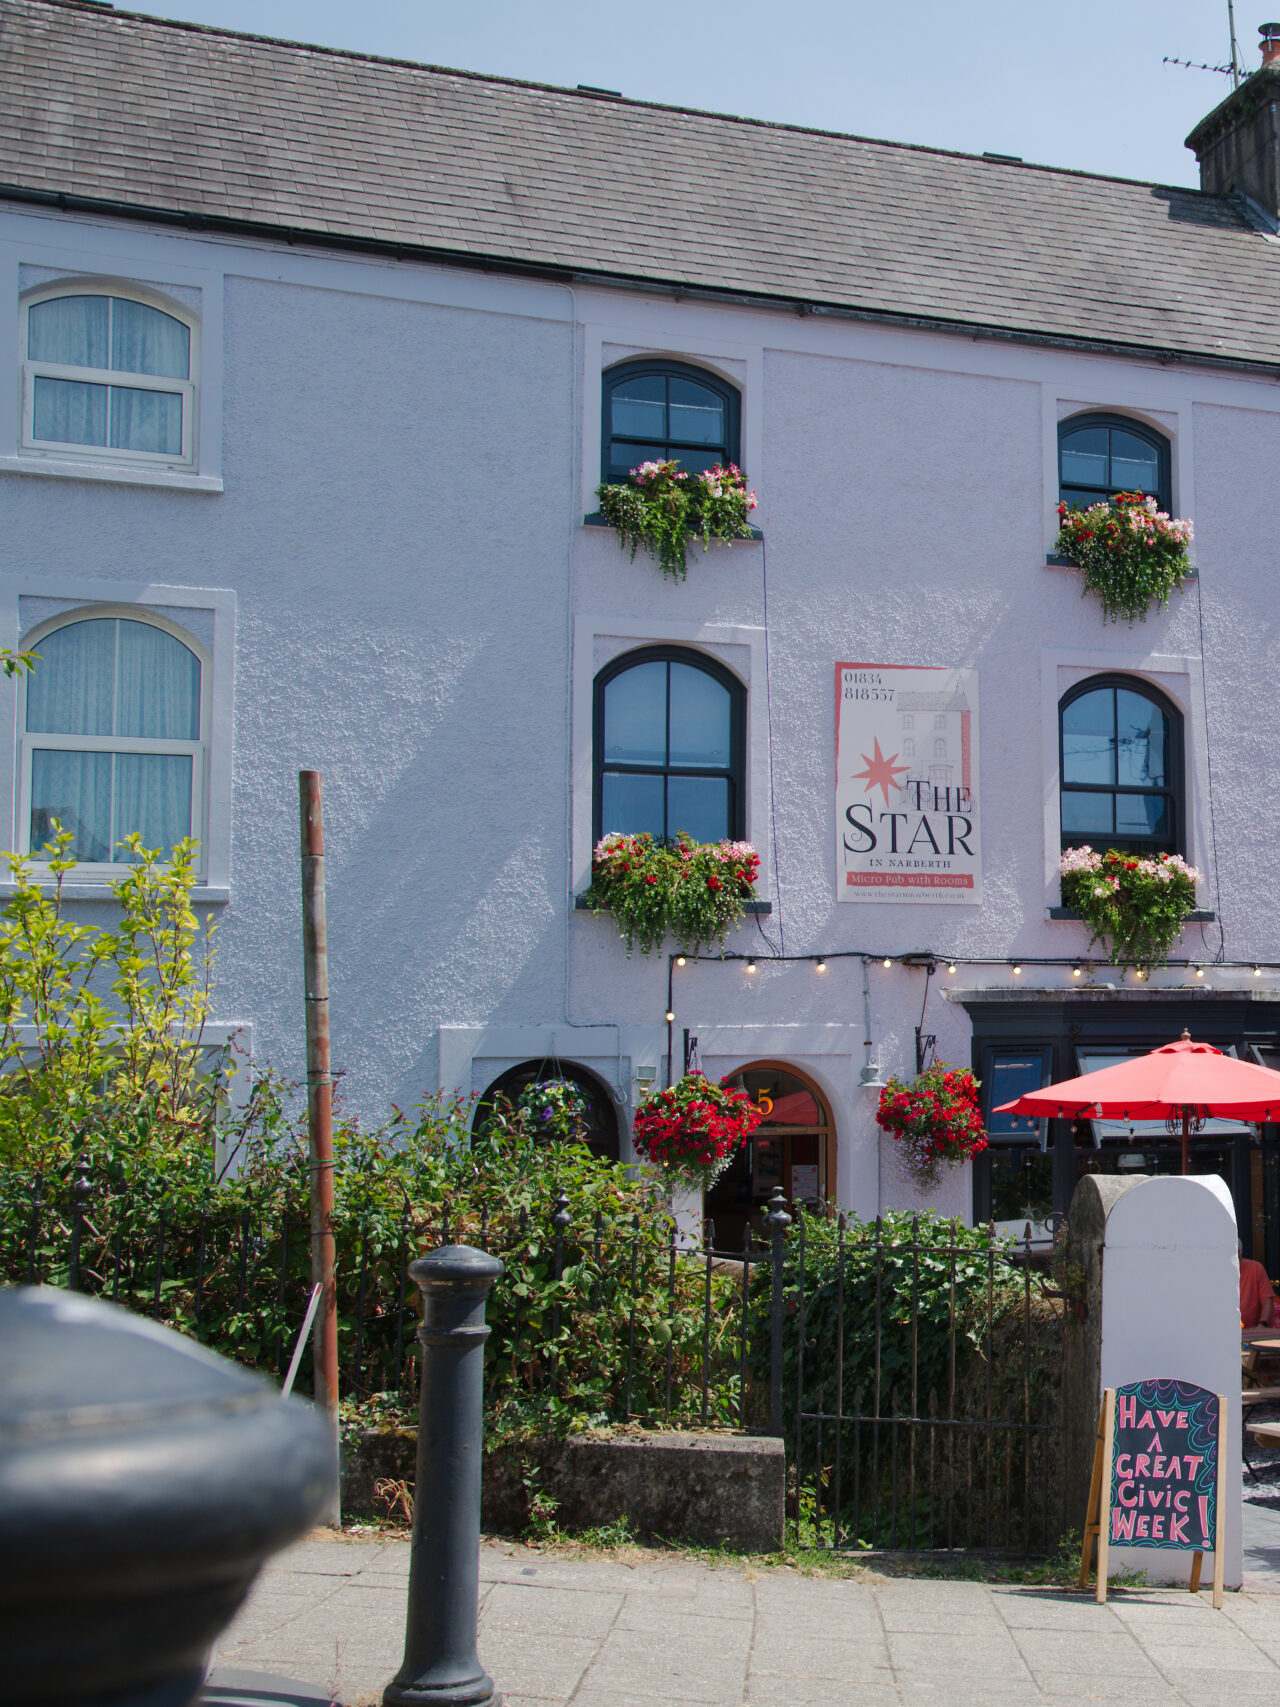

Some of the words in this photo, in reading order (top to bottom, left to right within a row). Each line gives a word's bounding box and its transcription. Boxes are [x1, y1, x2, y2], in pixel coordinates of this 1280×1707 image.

[844, 672, 882, 685] 01834
[906, 775, 972, 813] THE
[843, 799, 976, 860] STAR
[869, 859, 883, 867] IN
[889, 859, 951, 868] NARBERTH
[851, 875, 882, 884] Micro
[886, 875, 905, 885] Pub
[908, 876, 931, 885] with
[934, 876, 968, 886] Rooms
[757, 1088, 774, 1115] 5
[1119, 1395, 1189, 1429] HAVE
[1147, 1432, 1162, 1452] A
[1116, 1453, 1204, 1481] GREAT
[1118, 1480, 1191, 1512] Civic
